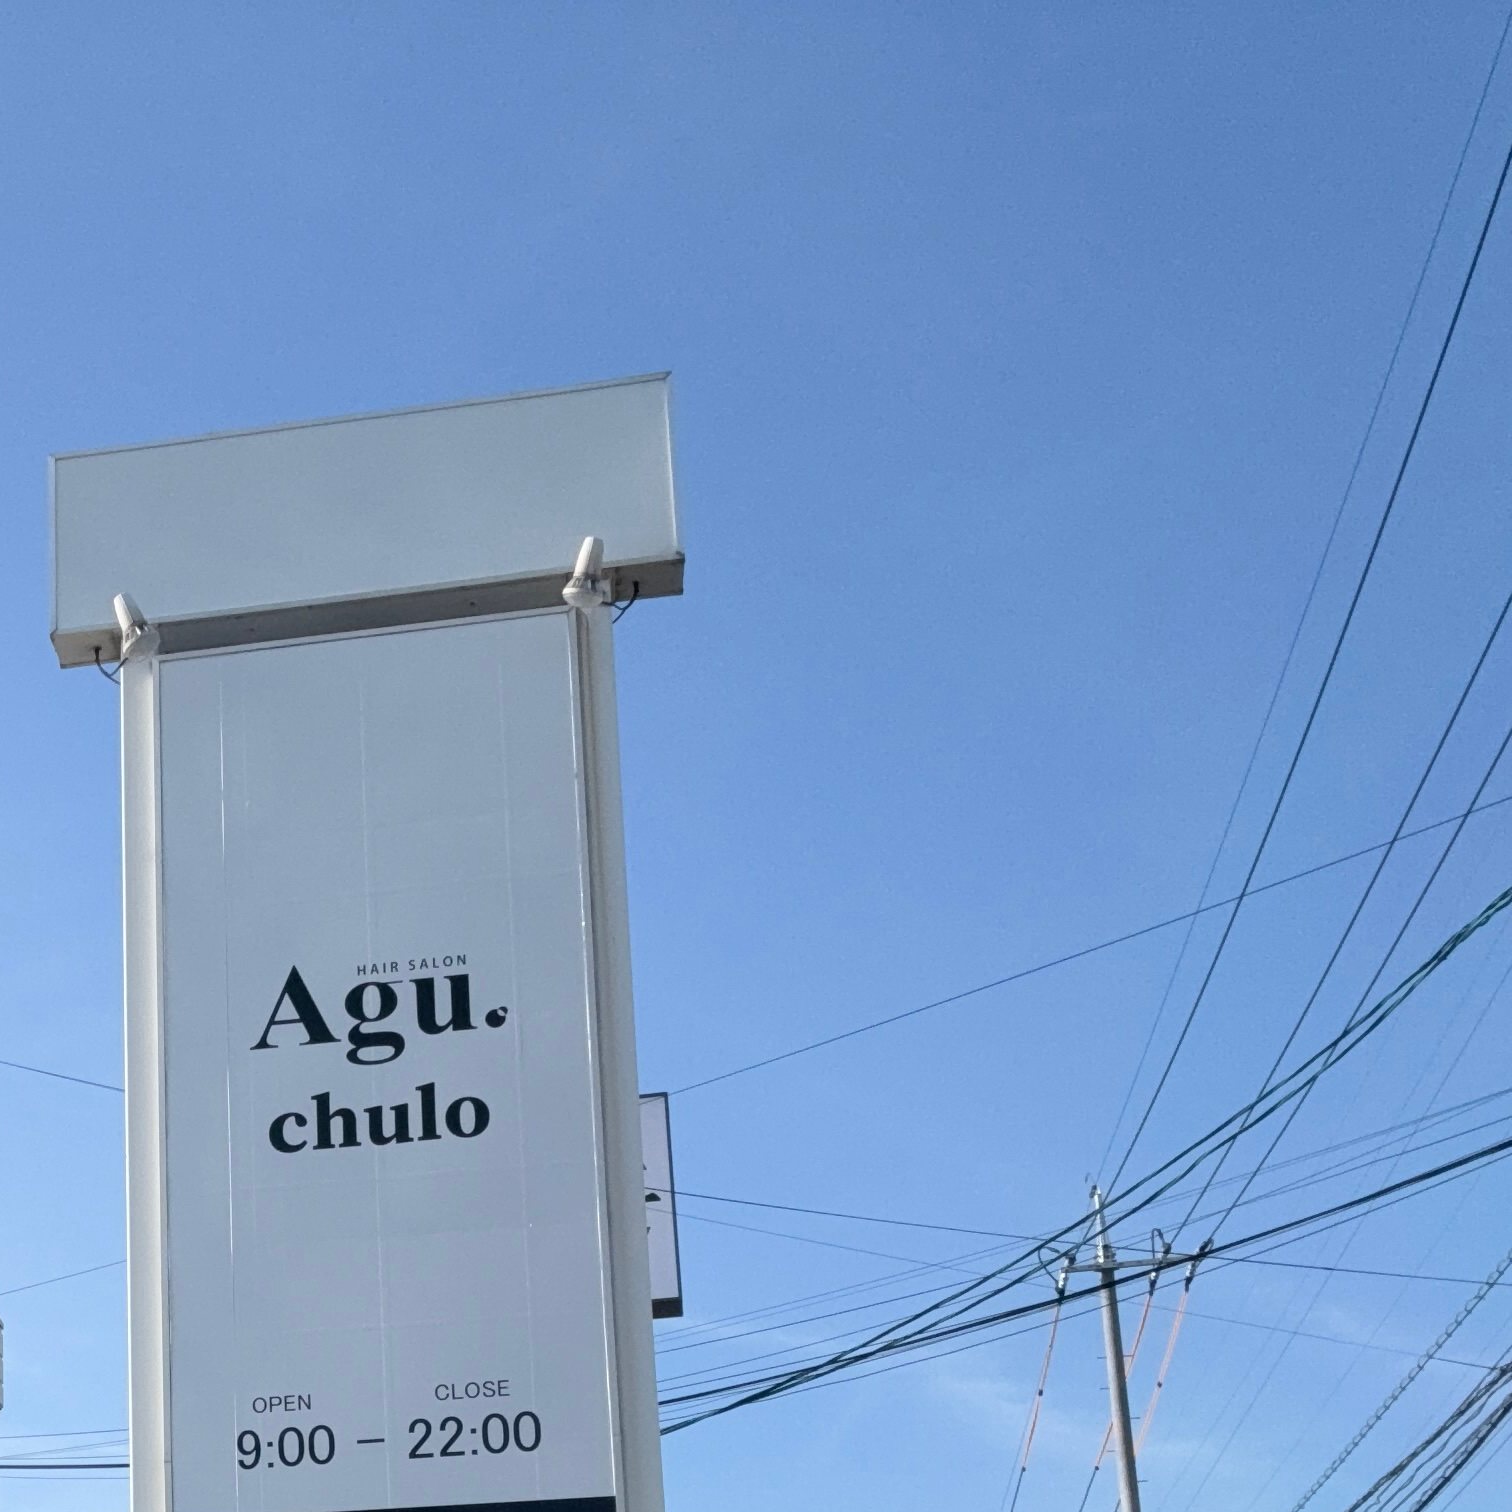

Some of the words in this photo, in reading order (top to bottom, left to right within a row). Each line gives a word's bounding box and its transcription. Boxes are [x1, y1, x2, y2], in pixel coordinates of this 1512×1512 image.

[356, 961, 400, 977] HAIR
[407, 954, 469, 971] SALON
[249, 965, 509, 1066] Agu.
[268, 1081, 491, 1154] chulo
[252, 1393, 312, 1414] OPEN
[434, 1379, 510, 1401] CLOSE
[235, 1424, 336, 1470] 9:00
[408, 1410, 542, 1460] 22:00
